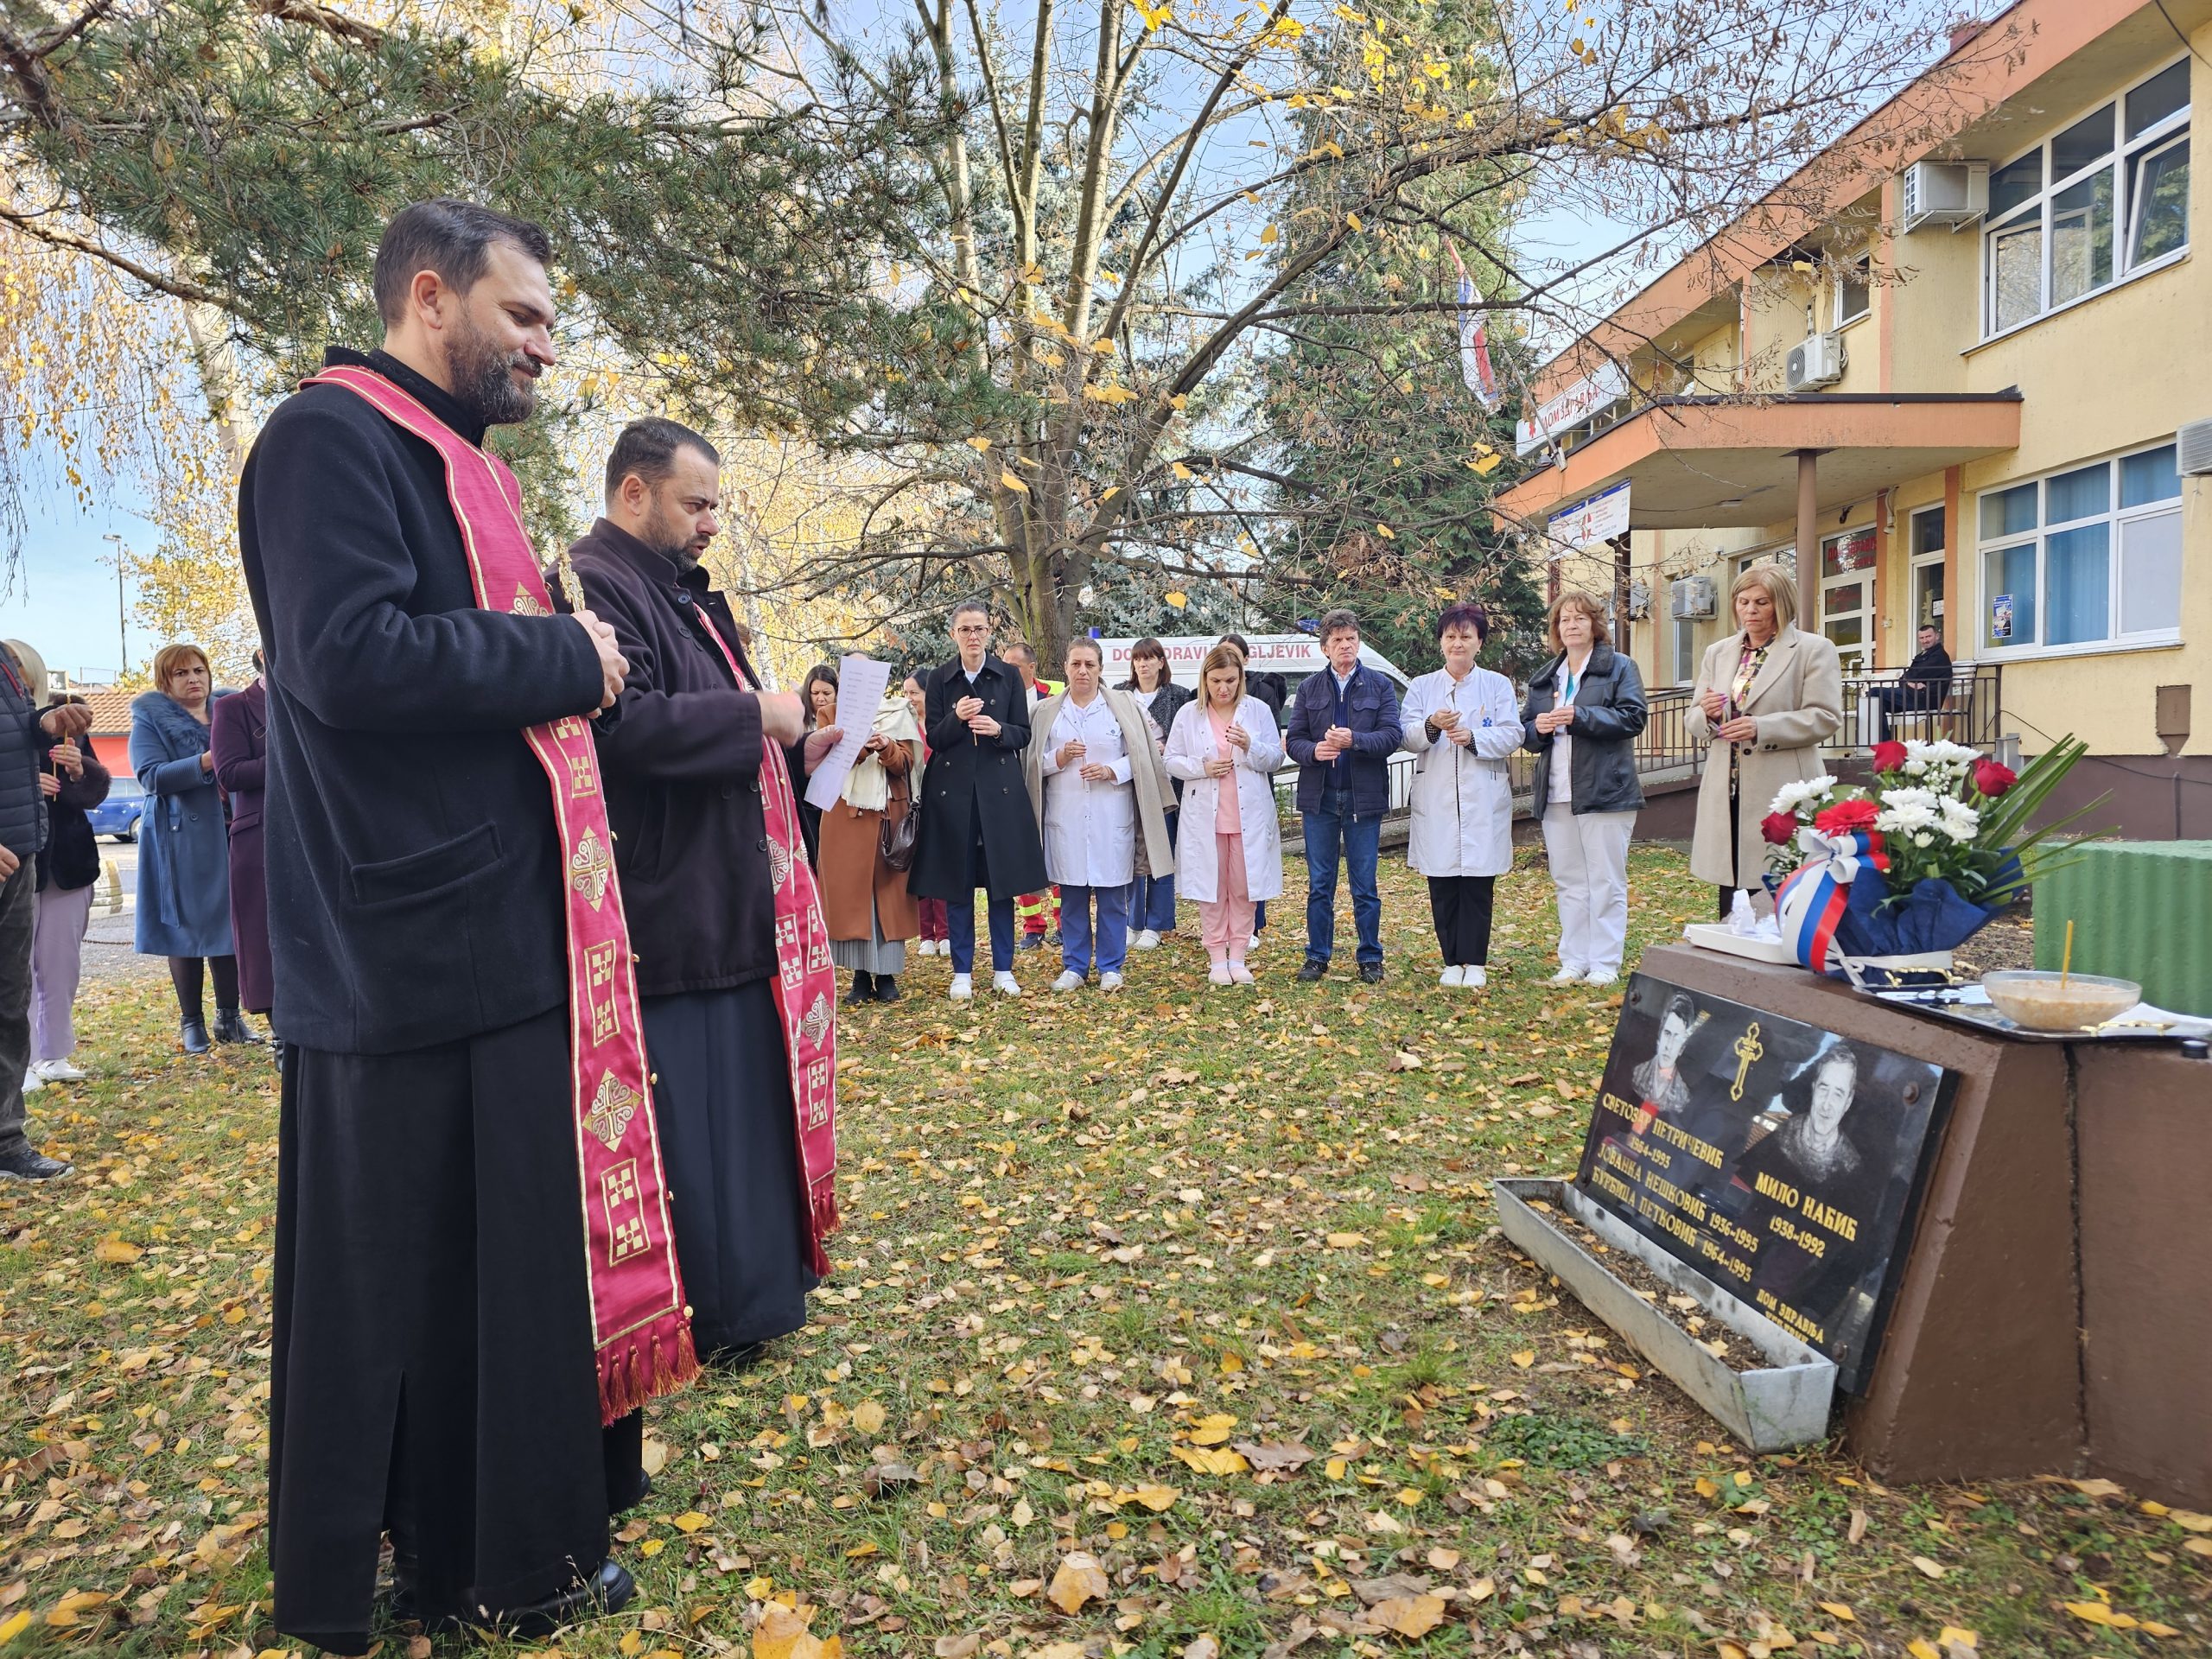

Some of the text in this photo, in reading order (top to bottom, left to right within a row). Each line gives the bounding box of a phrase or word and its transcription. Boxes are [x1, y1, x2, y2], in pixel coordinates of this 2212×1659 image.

[1112, 648, 1132, 661] DO
[1249, 645, 1311, 658] GLJEVIK
[1644, 1170, 1707, 1223] НЕШКОВИЋ
[1755, 1172, 1799, 1208] МИЛО
[1638, 1197, 1698, 1248] ПЕТКОВИЋ
[1756, 1288, 1778, 1312] ДОМ
